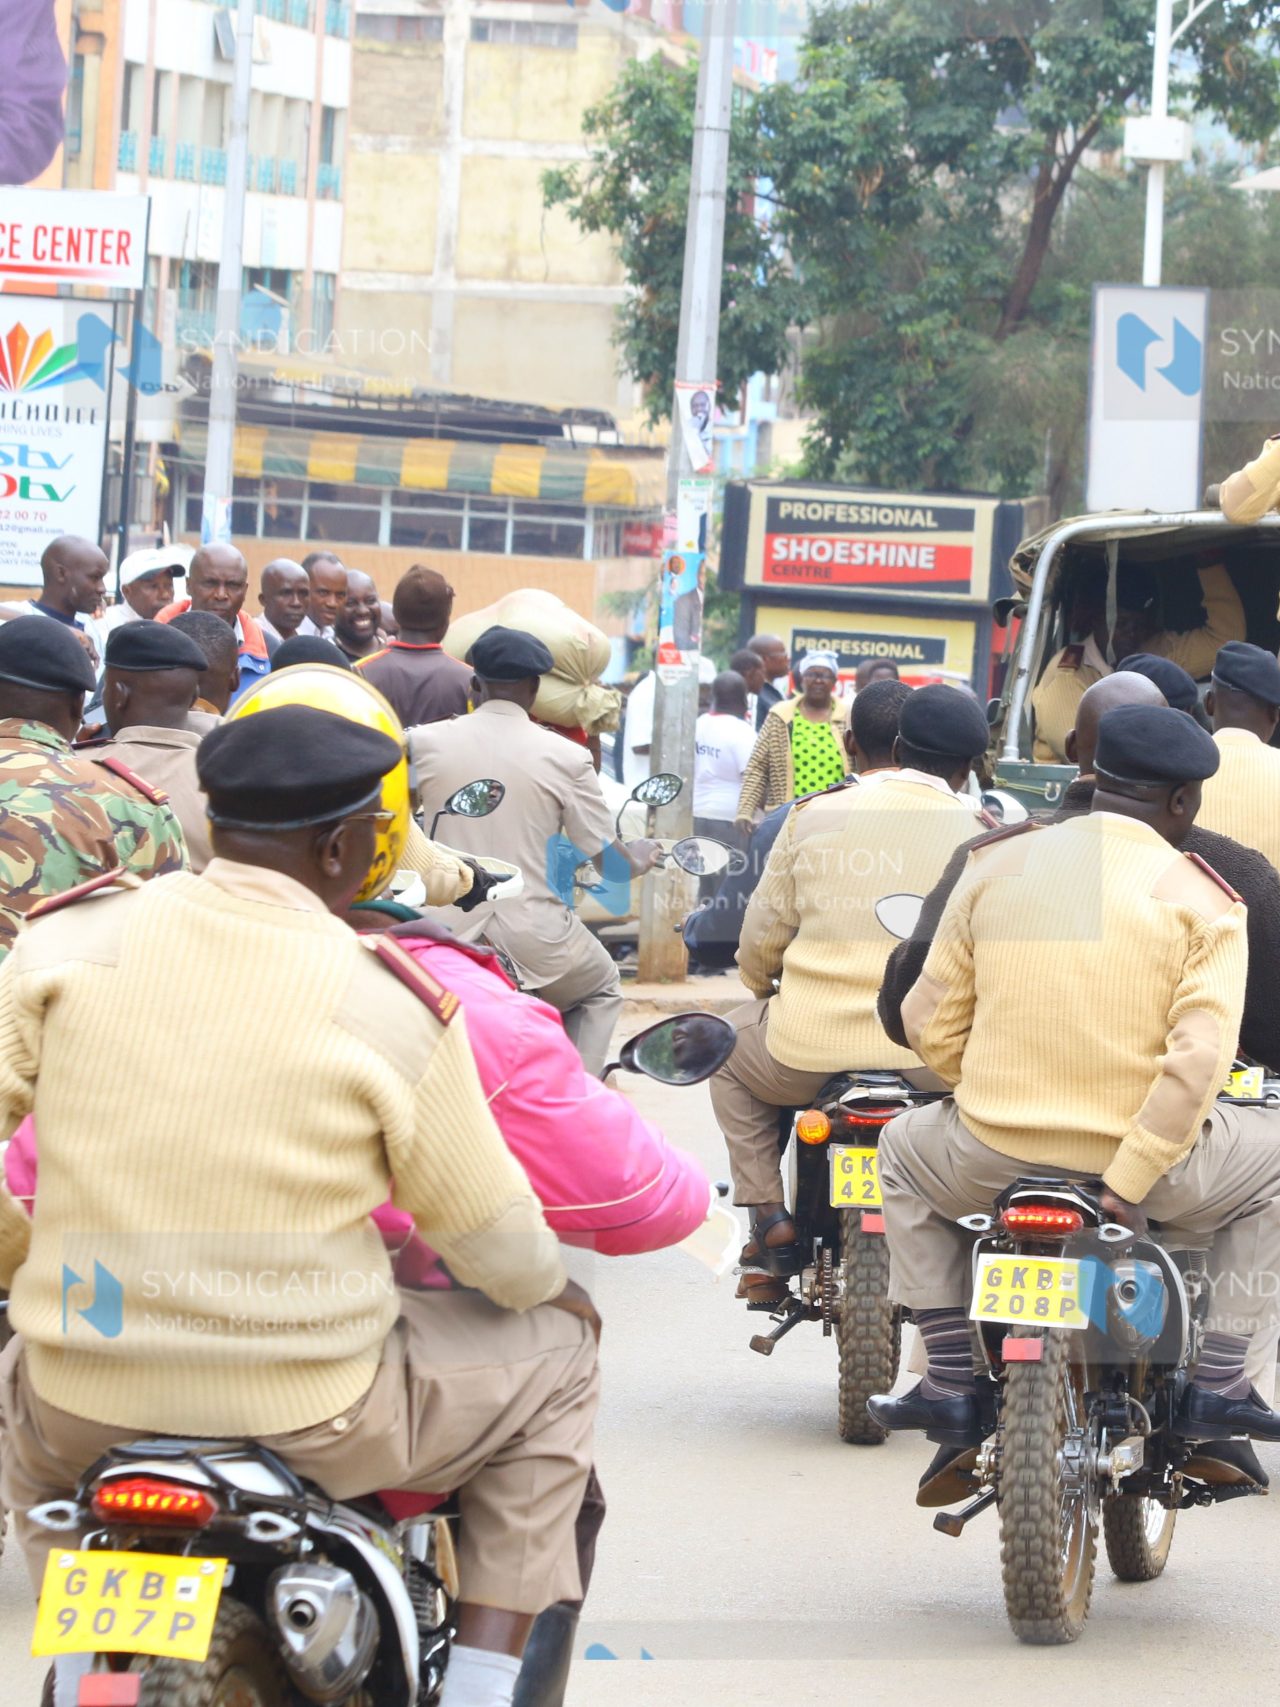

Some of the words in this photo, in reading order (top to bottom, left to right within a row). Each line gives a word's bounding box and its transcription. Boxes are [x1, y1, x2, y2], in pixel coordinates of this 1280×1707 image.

[33, 224, 131, 266] CENTER
[779, 501, 938, 528] PROFESSIONAL
[771, 536, 936, 570] SHOESHINE
[771, 564, 833, 579] CENTRE
[794, 636, 925, 660] PROFESSIONAL
[986, 1267, 1053, 1290] GKB
[982, 1293, 1076, 1318] 208P
[65, 1568, 166, 1601] GKB
[57, 1607, 197, 1640] 907P
